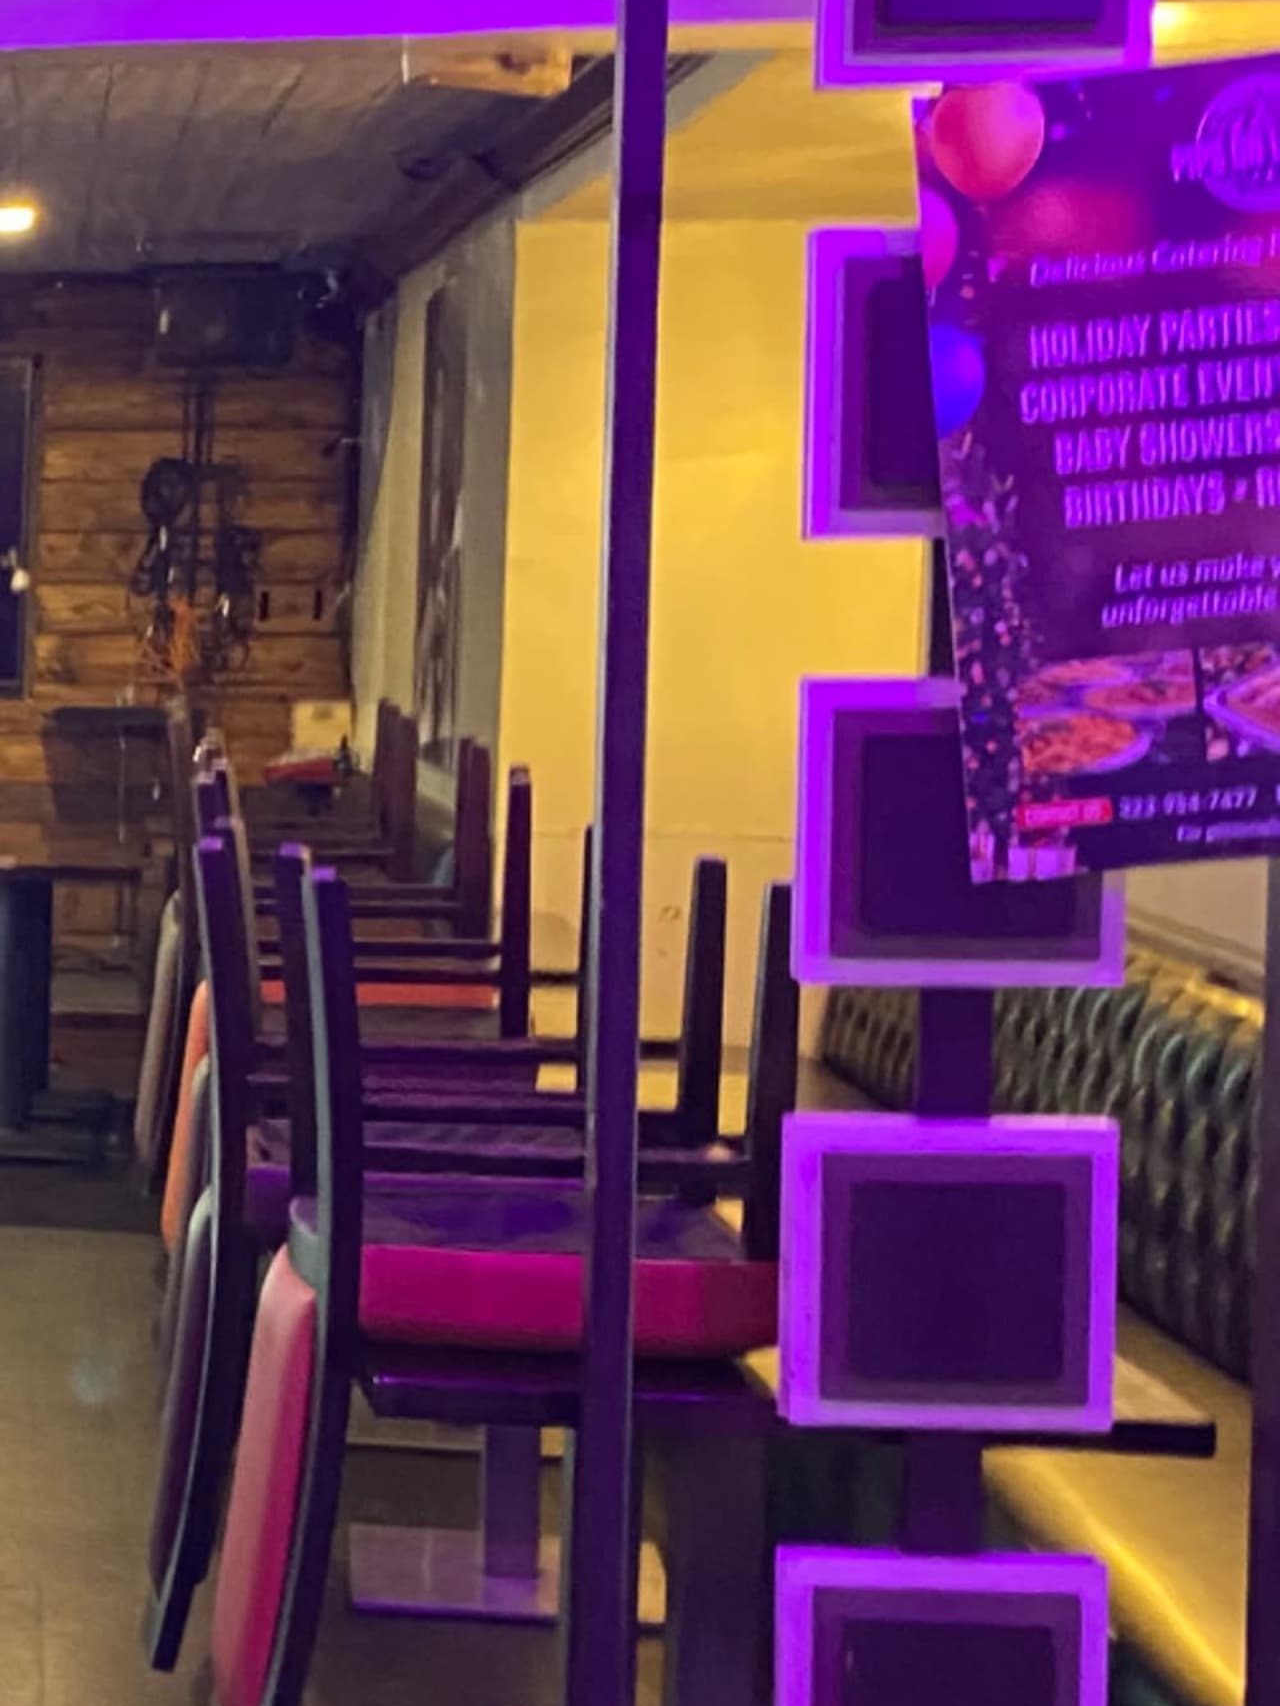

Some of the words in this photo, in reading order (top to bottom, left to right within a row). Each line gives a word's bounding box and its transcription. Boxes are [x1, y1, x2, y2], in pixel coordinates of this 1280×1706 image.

[1028, 313, 1151, 369] HOLIDAY
[1020, 362, 1189, 424] CORPORATE
[1198, 353, 1280, 406] EVEN
[1053, 423, 1132, 475] BABY
[1064, 468, 1226, 529] BIRTHDAYS
[1114, 561, 1153, 593] Let
[1160, 561, 1189, 588] us
[1194, 551, 1265, 585] make
[1101, 584, 1278, 629] unforgettable
